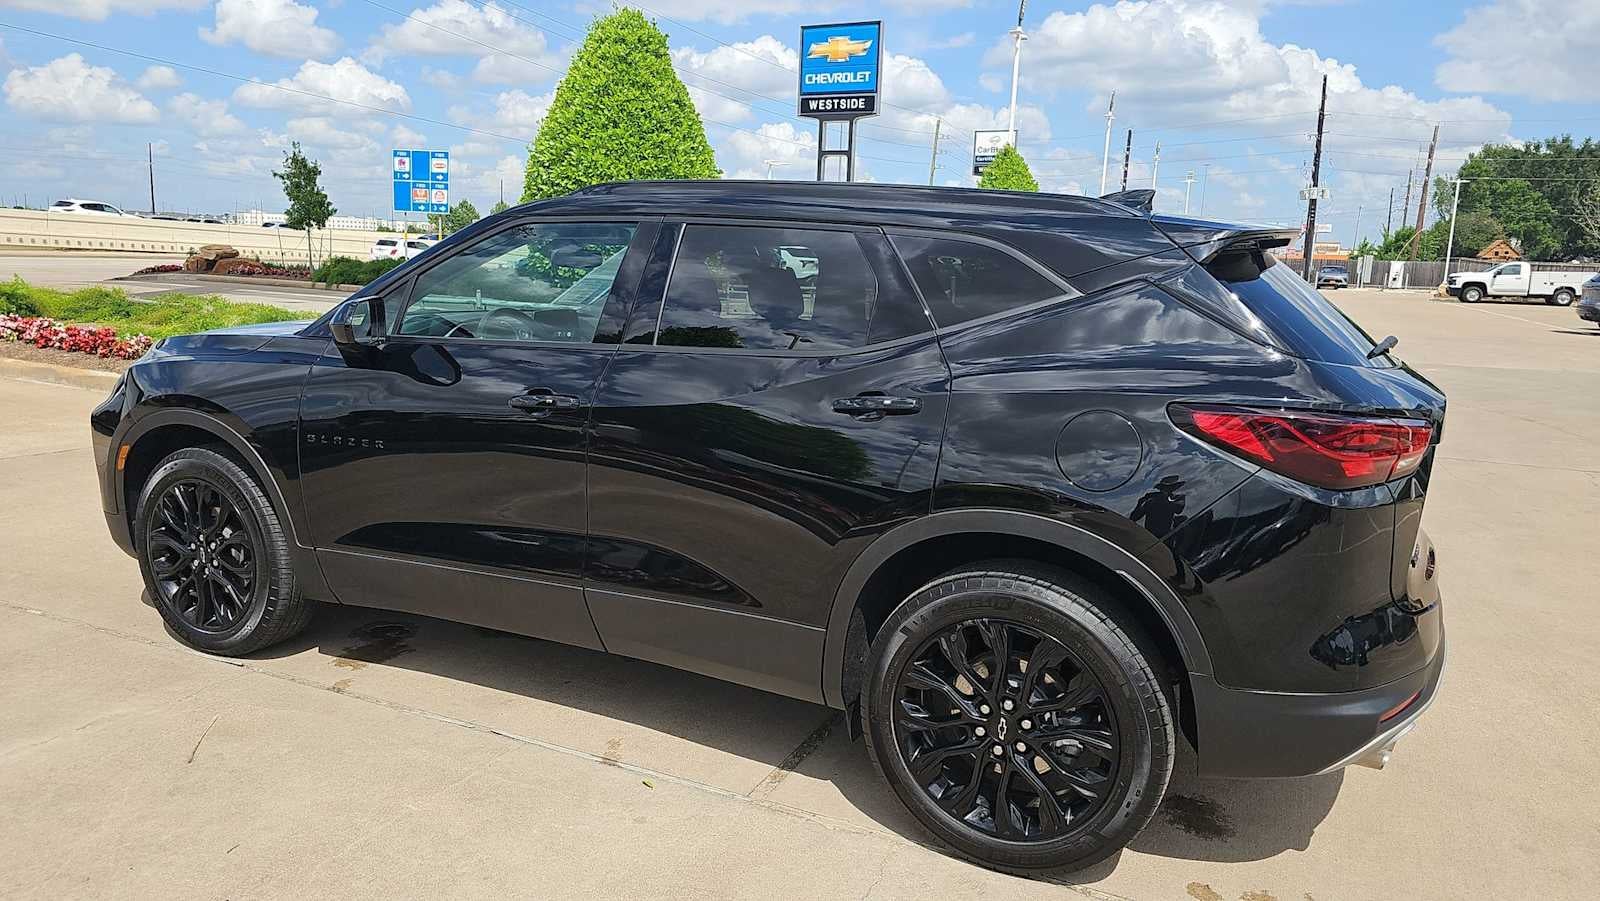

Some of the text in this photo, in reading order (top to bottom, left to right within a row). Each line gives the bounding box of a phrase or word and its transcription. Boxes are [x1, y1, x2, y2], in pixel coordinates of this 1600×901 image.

[805, 71, 872, 84] CHEVROLET
[809, 98, 866, 111] WESTSIDE
[306, 434, 384, 449] BLAZER
